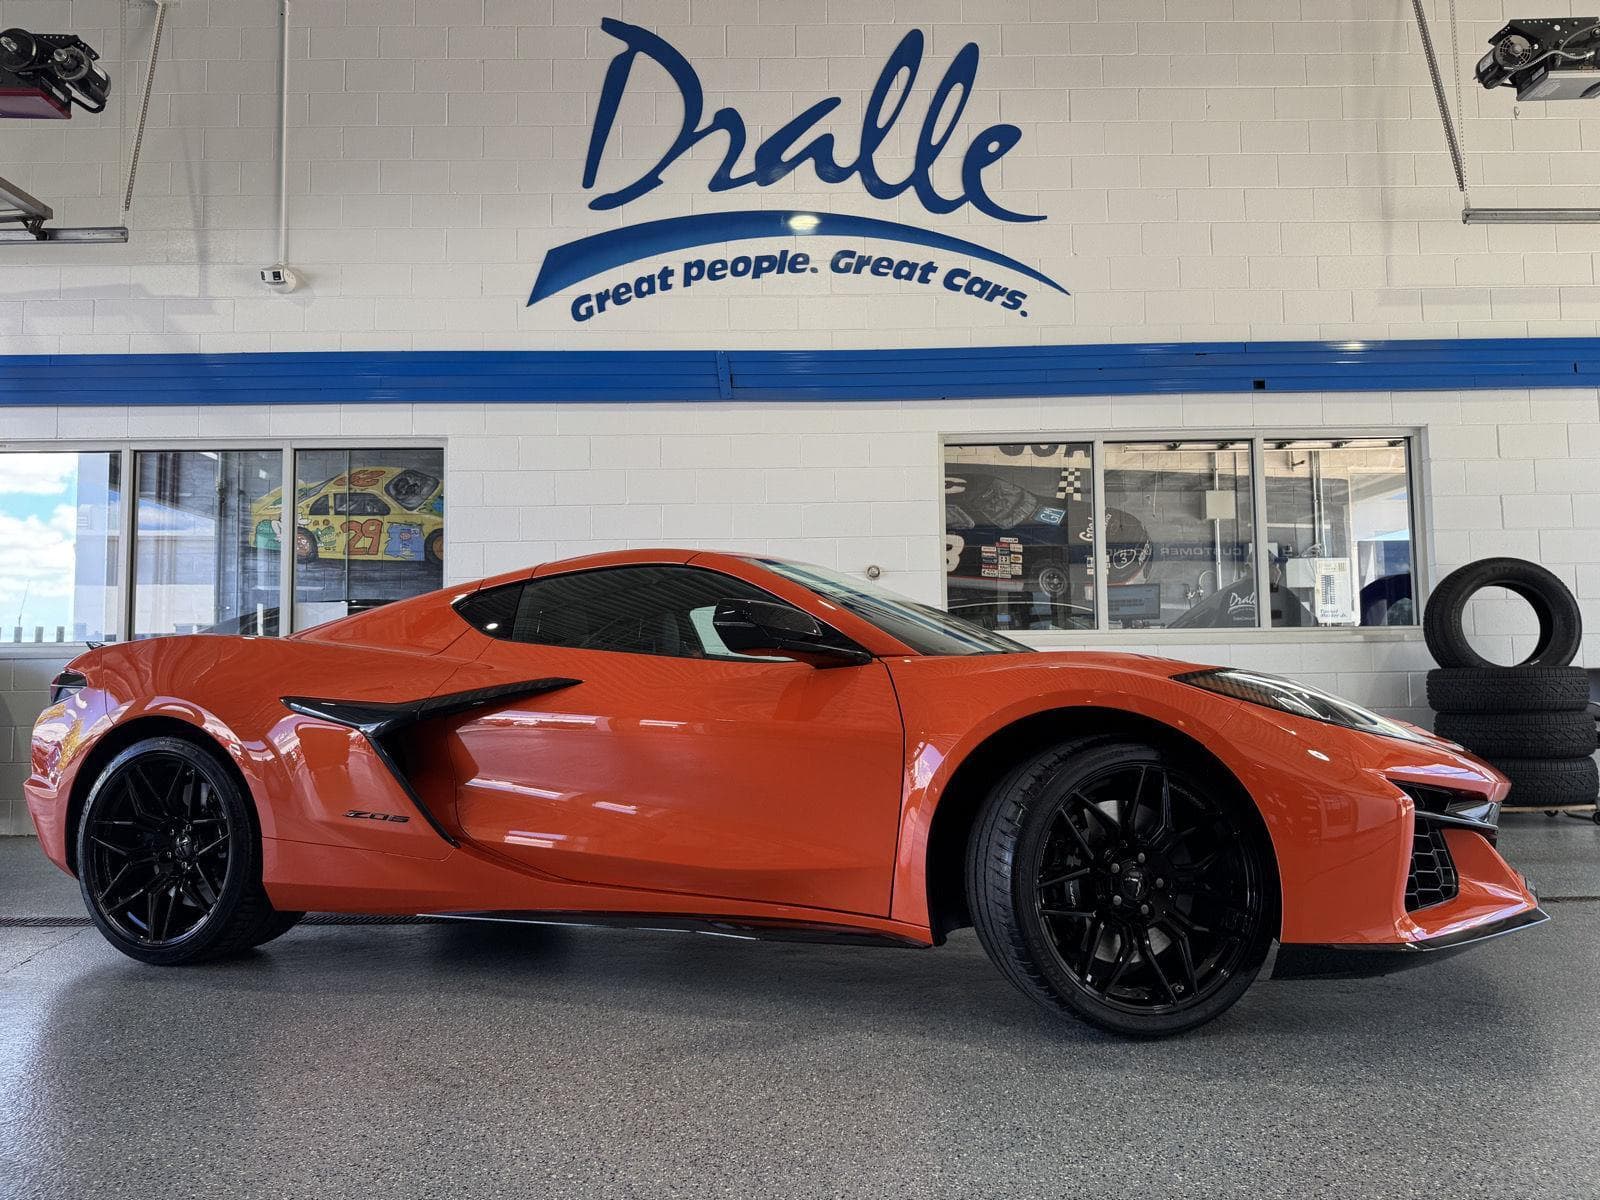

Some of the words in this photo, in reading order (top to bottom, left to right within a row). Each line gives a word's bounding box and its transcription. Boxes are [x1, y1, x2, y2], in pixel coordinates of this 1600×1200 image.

[583, 17, 1048, 223] Dralle
[571, 265, 675, 322] Great
[683, 250, 818, 288] people.
[830, 249, 938, 284] Great
[943, 268, 1028, 318] Cars.
[340, 518, 382, 555] 29
[1119, 552, 1128, 563] 3
